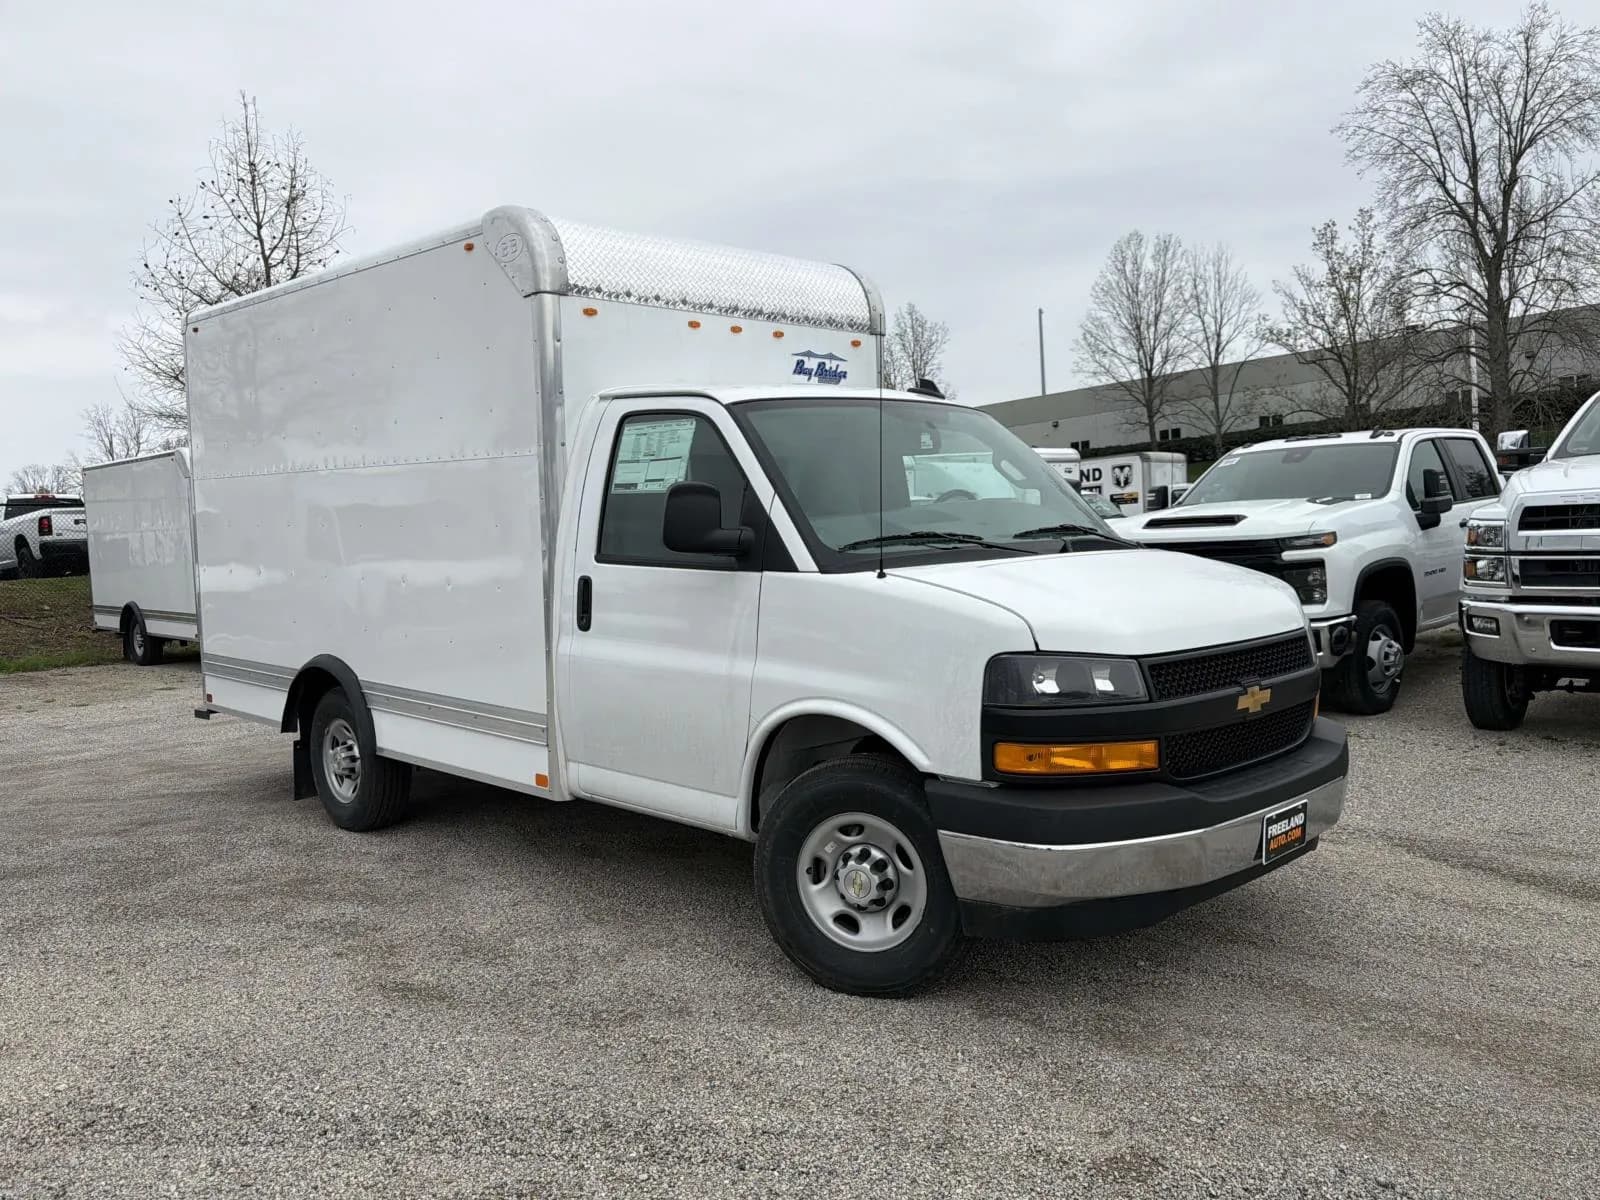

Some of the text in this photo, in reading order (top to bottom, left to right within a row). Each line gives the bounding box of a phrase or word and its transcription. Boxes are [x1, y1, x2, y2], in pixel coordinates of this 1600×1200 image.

[792, 359, 847, 385] Bay Bridge
[1268, 812, 1305, 839] FREELAND
[1270, 826, 1302, 850] AUTO.COM
